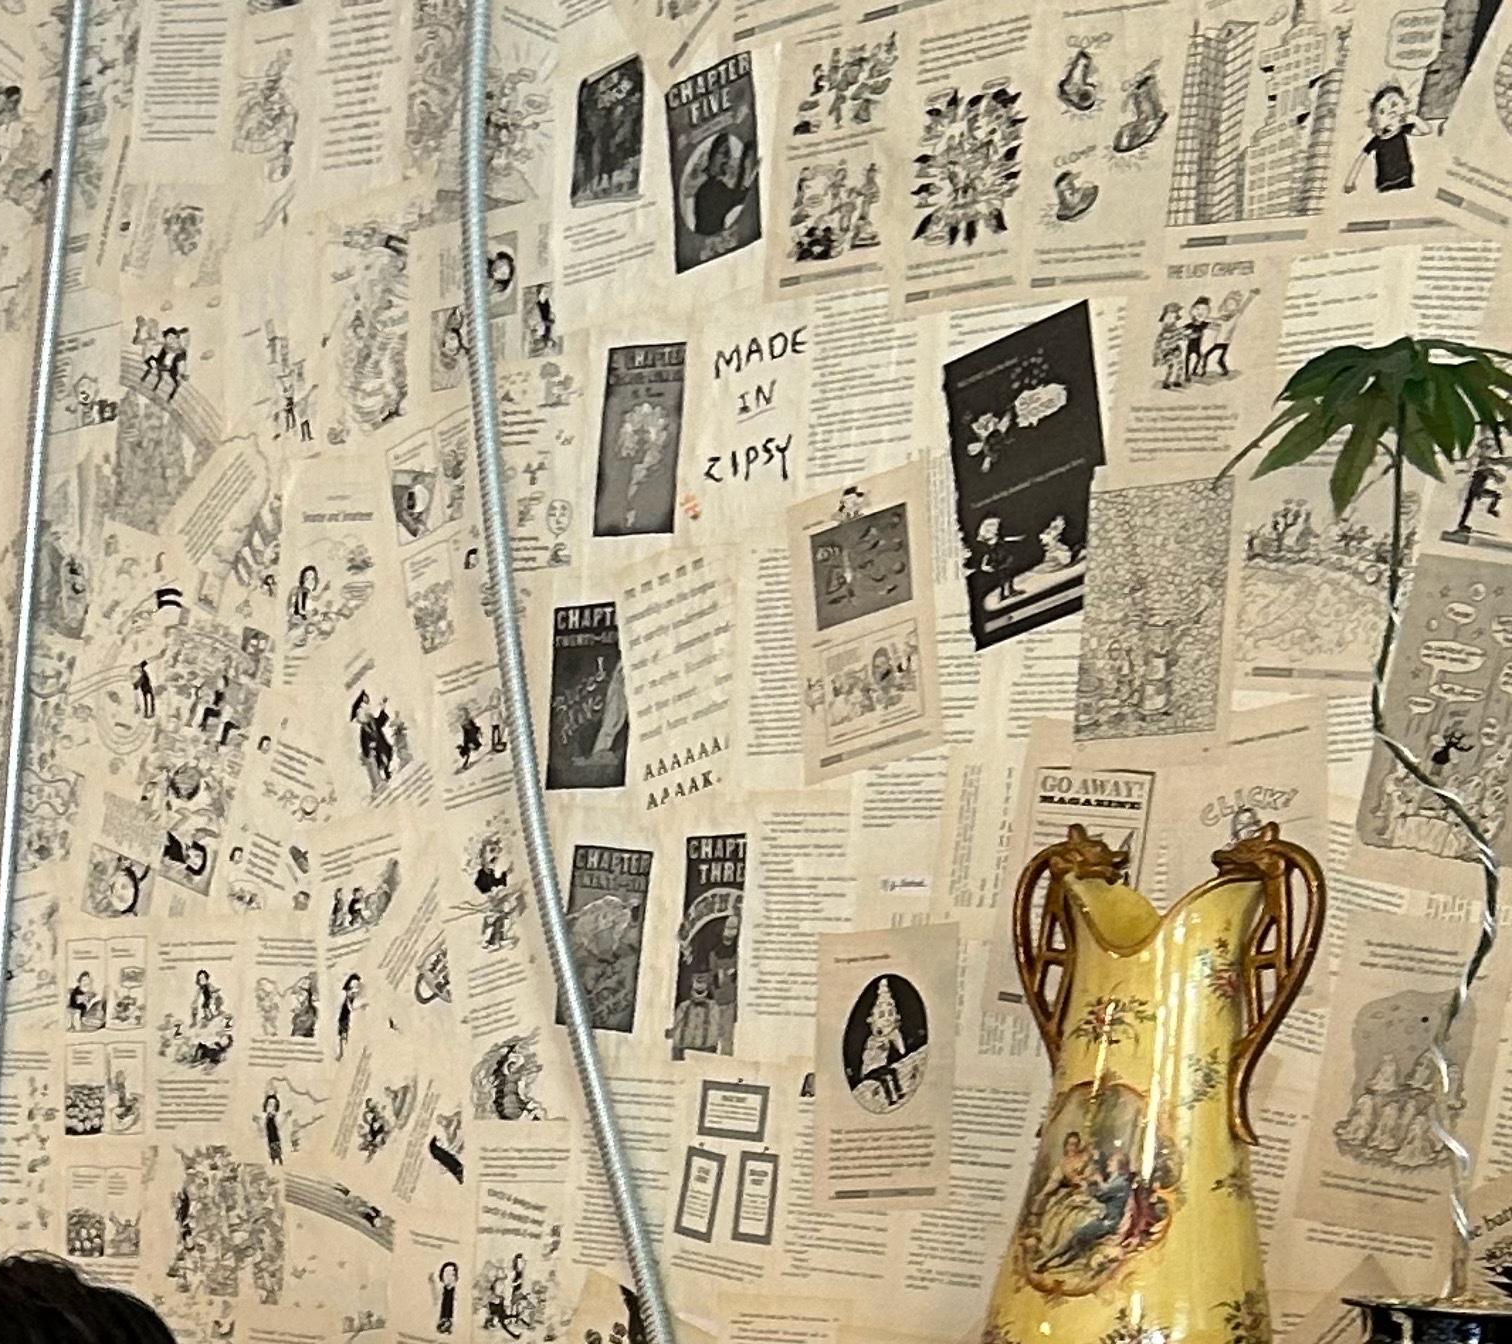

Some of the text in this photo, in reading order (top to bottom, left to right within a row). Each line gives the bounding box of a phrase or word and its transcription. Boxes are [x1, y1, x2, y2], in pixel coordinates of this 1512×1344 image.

[667, 53, 752, 110] CHAPTER
[689, 87, 733, 126] FIVE
[714, 324, 808, 380] MADE
[737, 378, 777, 414] IN
[703, 433, 793, 482] ZIPSY
[1040, 775, 1073, 794] GO
[575, 848, 652, 876] CHAPTER
